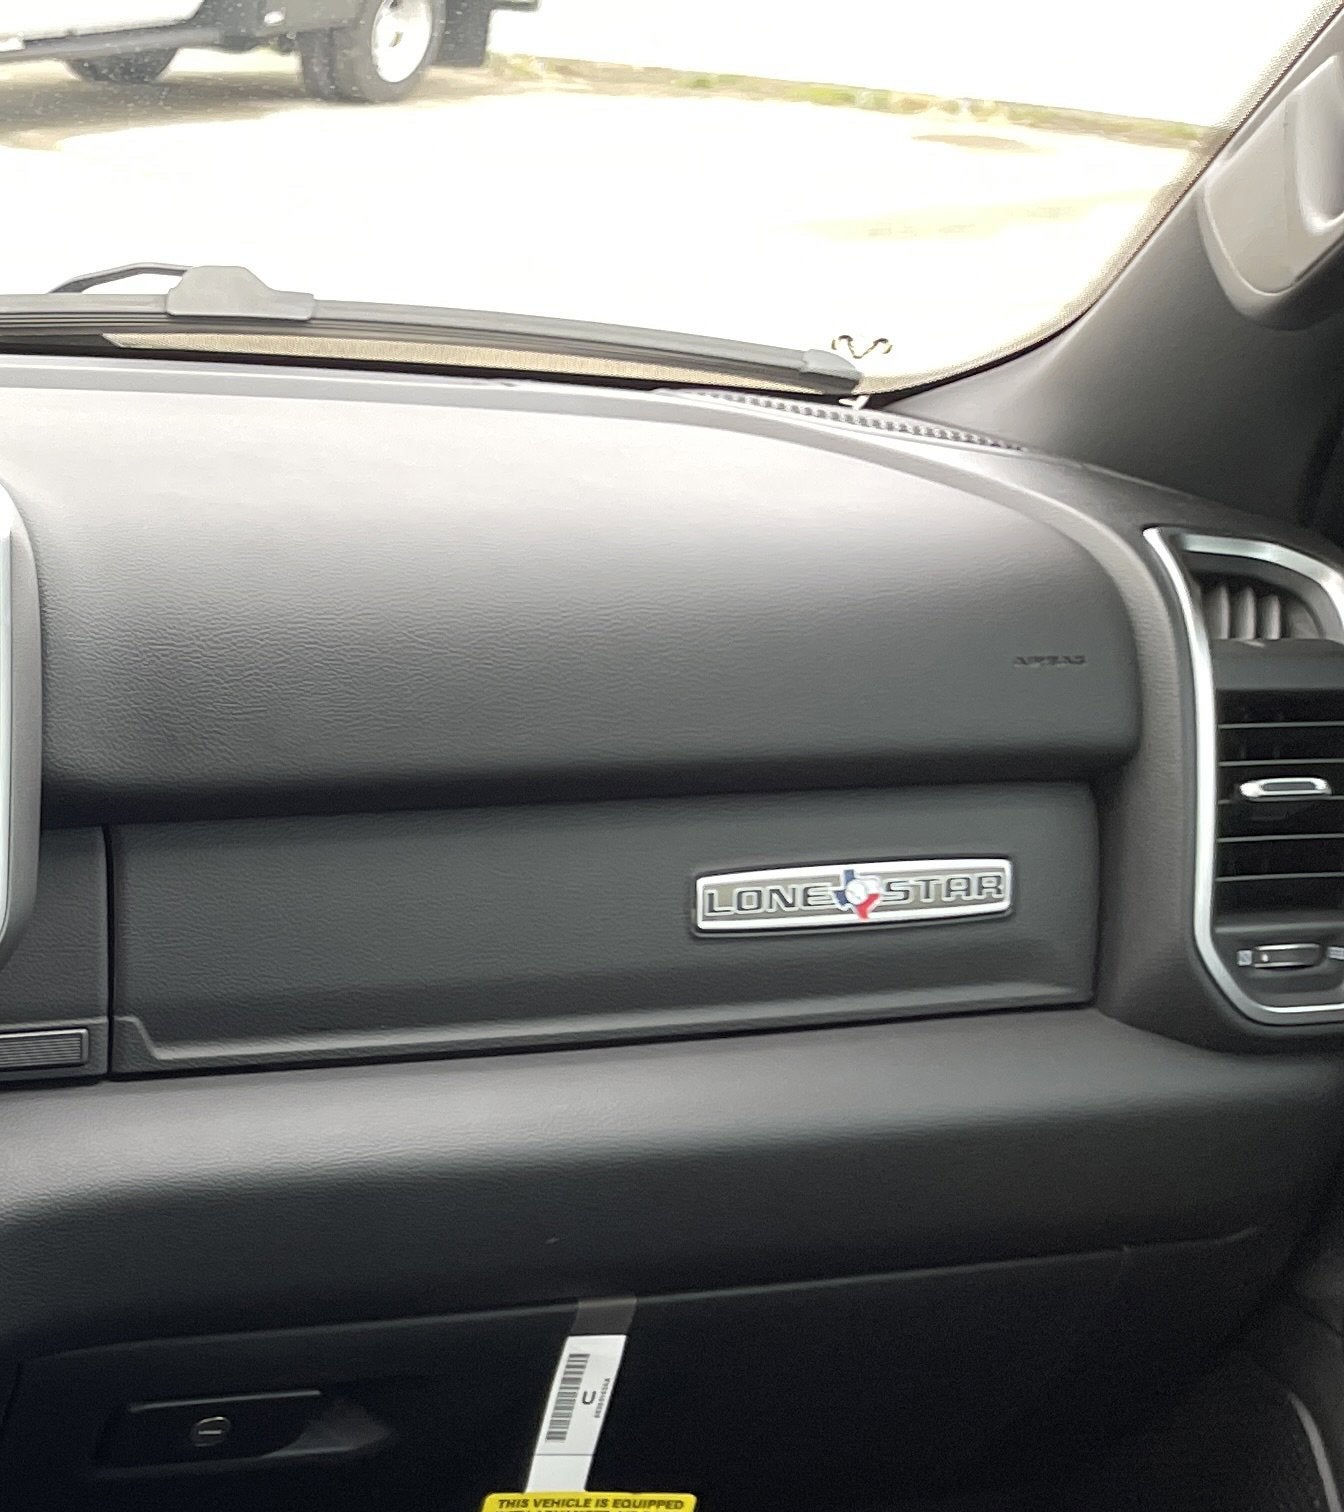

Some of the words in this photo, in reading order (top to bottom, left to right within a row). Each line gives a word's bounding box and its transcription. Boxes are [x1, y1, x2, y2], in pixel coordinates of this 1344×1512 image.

[706, 882, 835, 917] LONE
[885, 874, 1008, 905] STAR
[582, 1390, 597, 1405] U
[498, 1498, 530, 1509] THIS
[532, 1498, 591, 1509] VEHICLE
[594, 1498, 609, 1508] IS
[611, 1499, 685, 1510] EQUIPPED
